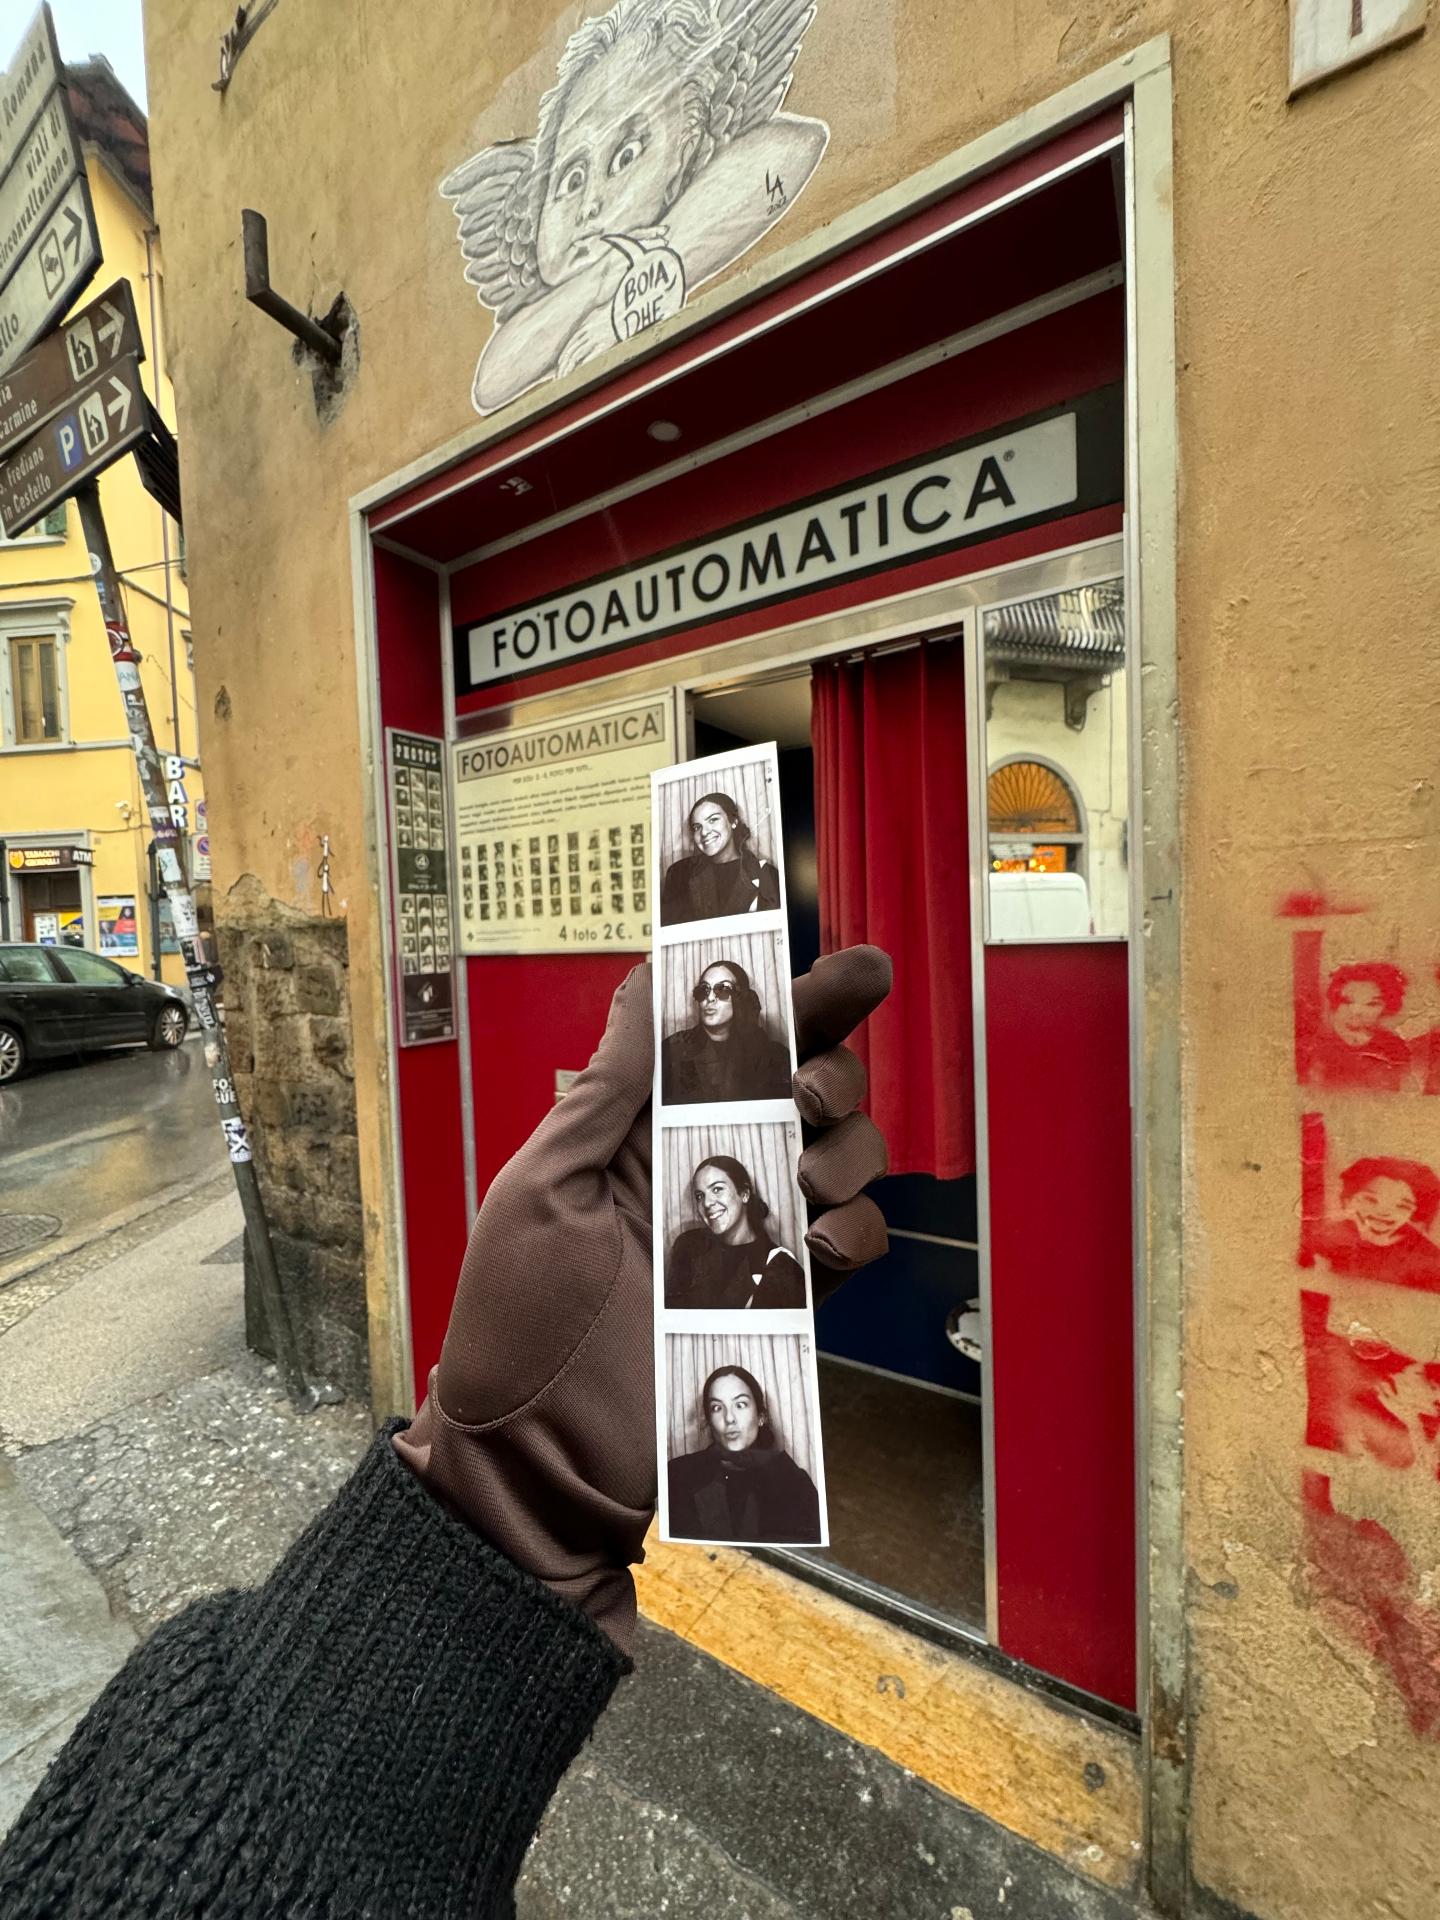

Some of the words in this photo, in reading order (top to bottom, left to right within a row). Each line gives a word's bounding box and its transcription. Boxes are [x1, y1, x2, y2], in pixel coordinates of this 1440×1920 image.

[50, 104, 61, 139] di
[6, 446, 45, 487] Frediano
[3, 503, 13, 521] in
[13, 472, 51, 514] Cestello
[165, 755, 189, 829] BAR
[72, 850, 92, 863] ATM
[559, 924, 568, 942] 4
[573, 927, 598, 942] foto
